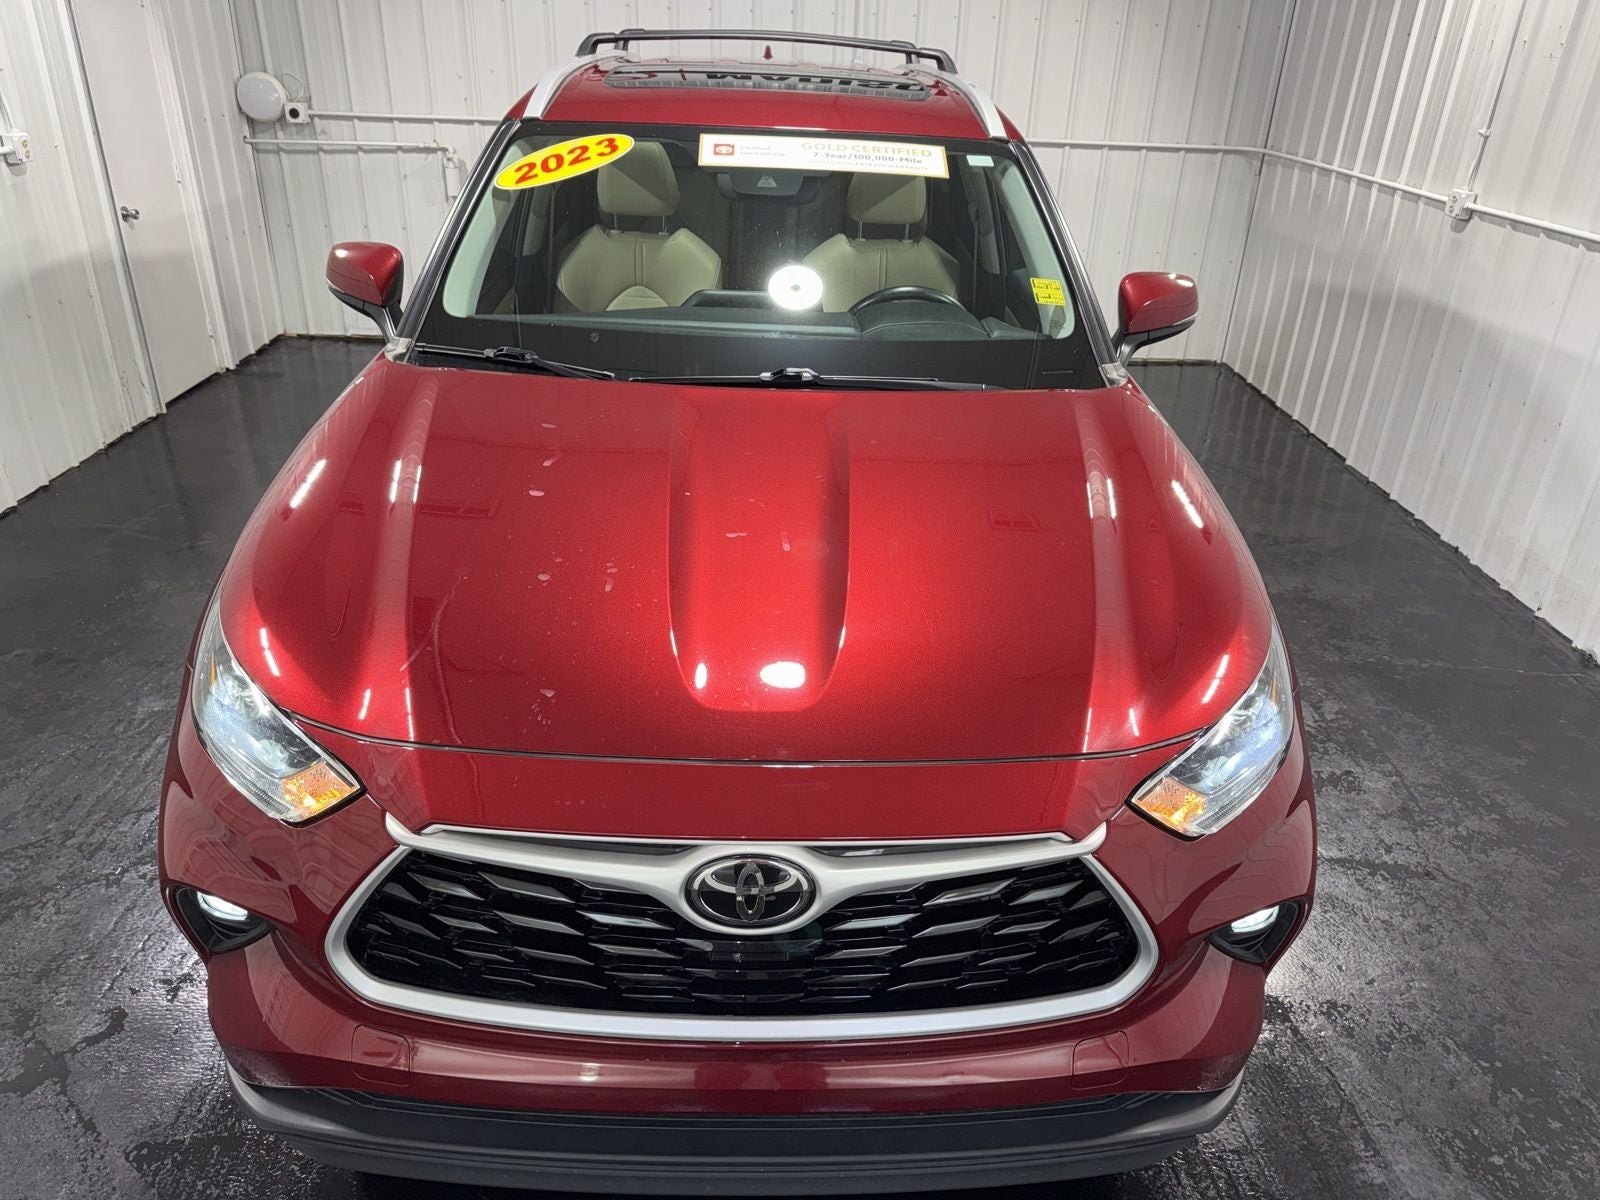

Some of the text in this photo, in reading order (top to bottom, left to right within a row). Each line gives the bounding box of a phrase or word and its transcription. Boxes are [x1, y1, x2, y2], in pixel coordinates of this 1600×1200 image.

[513, 136, 620, 186] 2023
[801, 142, 933, 158] GOLD CERTIFIED
